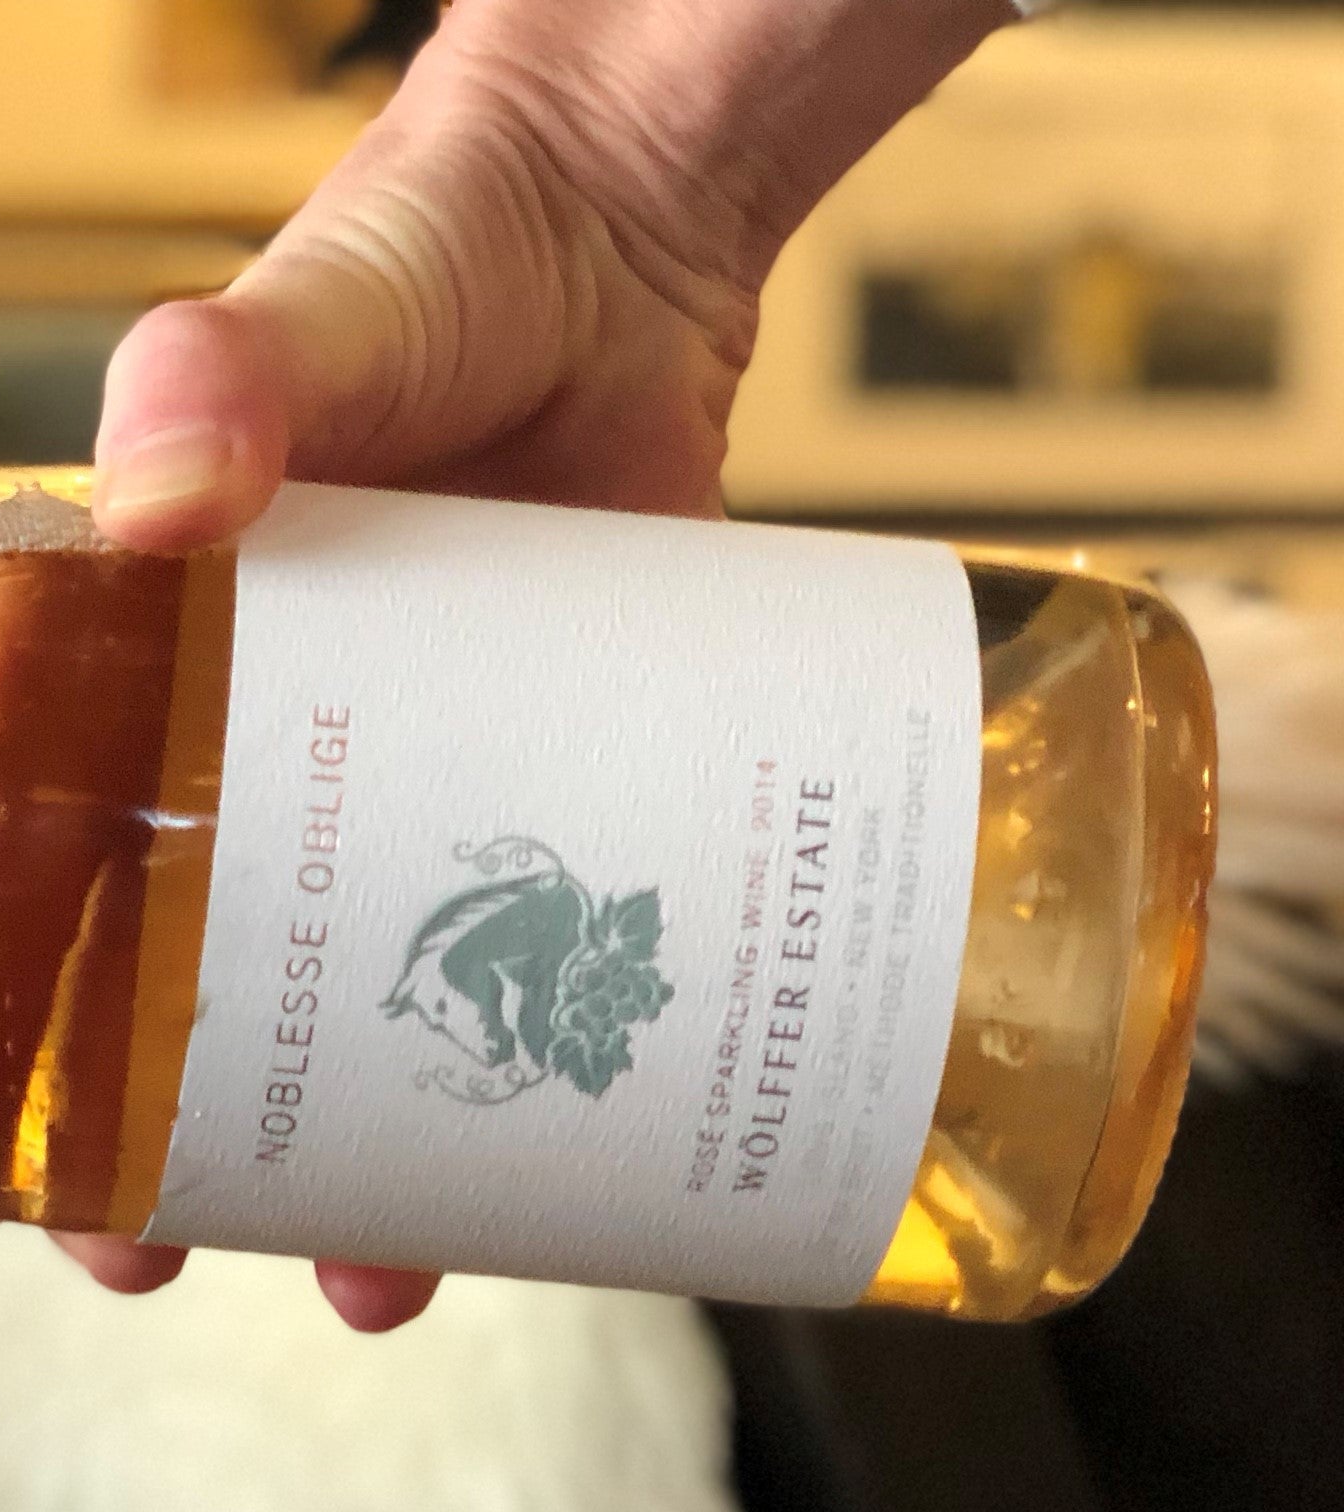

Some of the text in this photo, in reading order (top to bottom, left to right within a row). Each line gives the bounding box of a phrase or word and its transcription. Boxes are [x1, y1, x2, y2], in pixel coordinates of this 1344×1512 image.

[750, 755, 780, 833] 2014
[851, 806, 883, 886] YORK
[738, 847, 770, 931] WINE
[254, 702, 350, 1164] NOBLESSE OBLIGE
[841, 899, 873, 969] NEW
[730, 776, 835, 1194] WÖLFFER ESTATE
[705, 943, 760, 1118] SPARKLING
